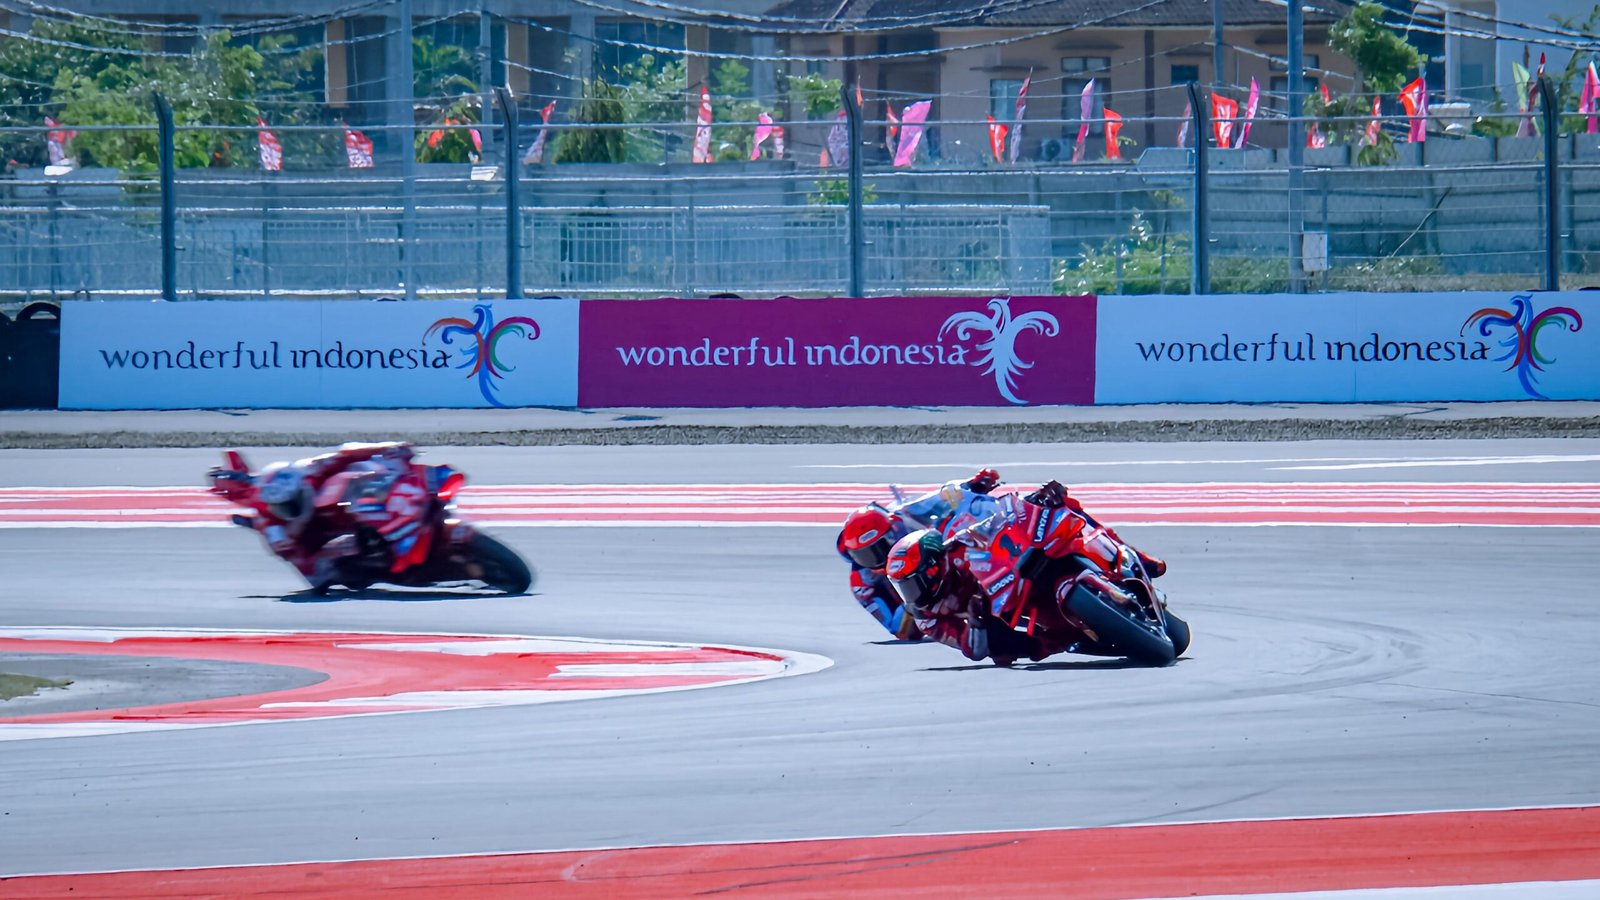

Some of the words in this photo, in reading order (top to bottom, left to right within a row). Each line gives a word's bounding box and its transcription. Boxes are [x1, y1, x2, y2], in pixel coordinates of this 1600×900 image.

[98, 340, 282, 370] wonderful
[616, 337, 797, 366] wonderful
[1135, 333, 1316, 362] wonderful
